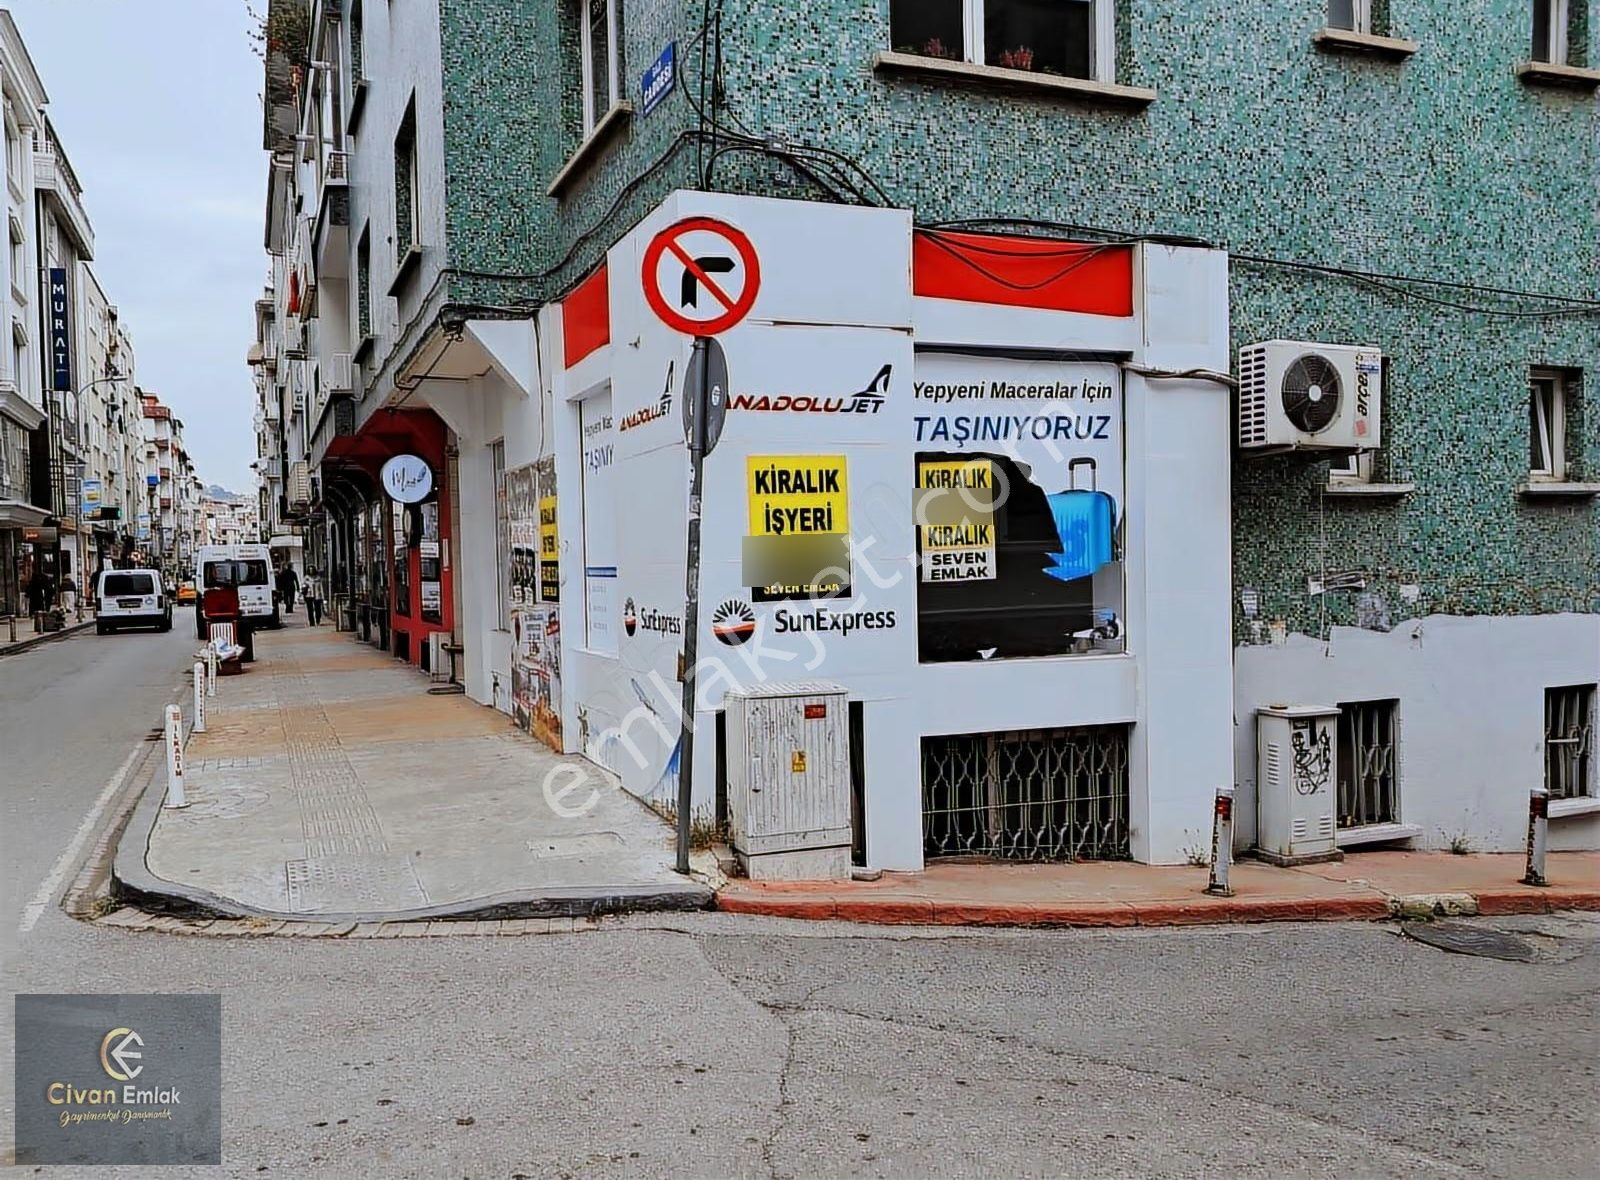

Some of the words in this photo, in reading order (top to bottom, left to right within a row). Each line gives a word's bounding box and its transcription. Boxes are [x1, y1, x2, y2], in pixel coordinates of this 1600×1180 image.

[52, 284, 67, 366] MURAT
[913, 382, 985, 404] Yepyeni
[990, 382, 1077, 399] Maceralar
[1081, 379, 1112, 403] İçin
[619, 399, 672, 432] ANADOLUJET
[913, 415, 1111, 448] TAŞINIYORUZ
[754, 465, 840, 495] KİRALIK
[765, 501, 833, 535] İŞYERİ
[930, 566, 989, 581] EMLAK
[931, 552, 987, 566] SEVEN
[774, 608, 896, 636] SunExpress
